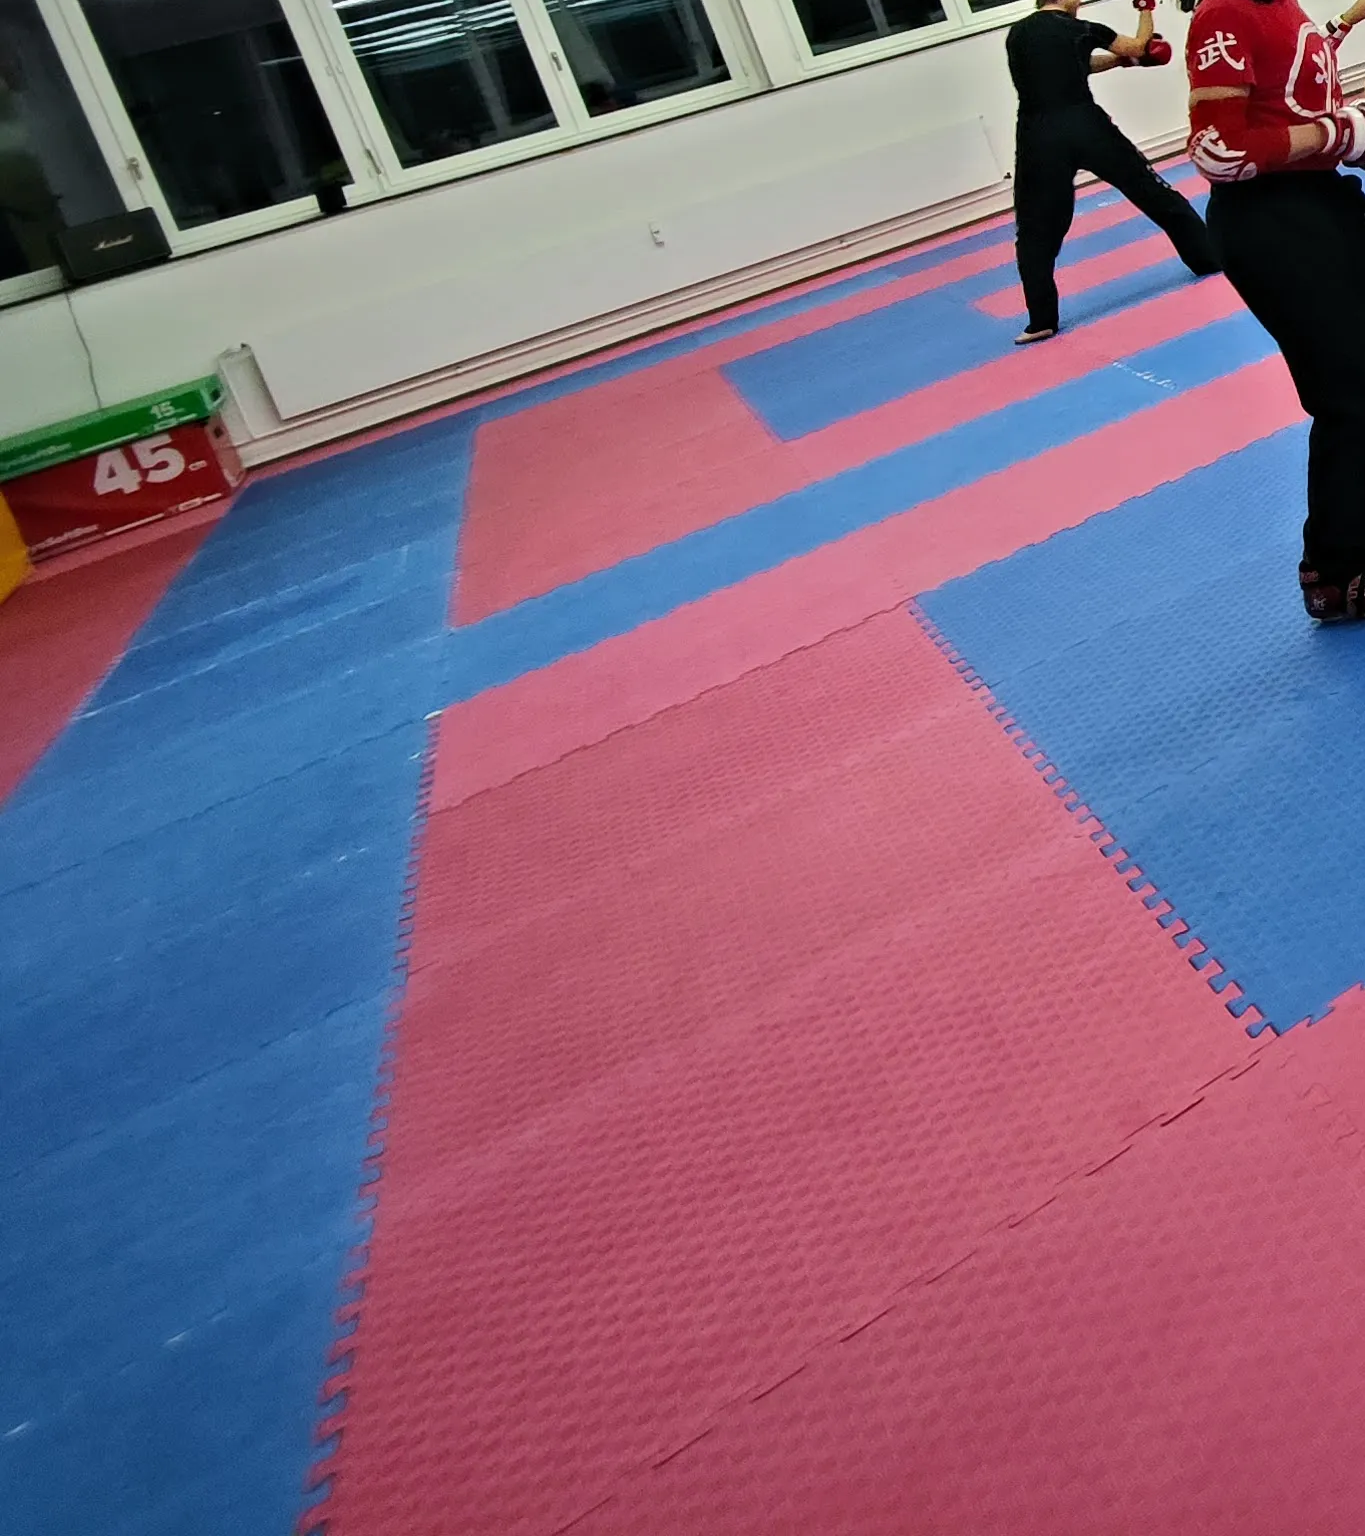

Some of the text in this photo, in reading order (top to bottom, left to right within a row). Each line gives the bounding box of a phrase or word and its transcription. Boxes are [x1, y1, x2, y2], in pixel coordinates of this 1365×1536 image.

[1197, 30, 1246, 72] 武
[150, 400, 175, 419] 15
[93, 432, 186, 496] 45
